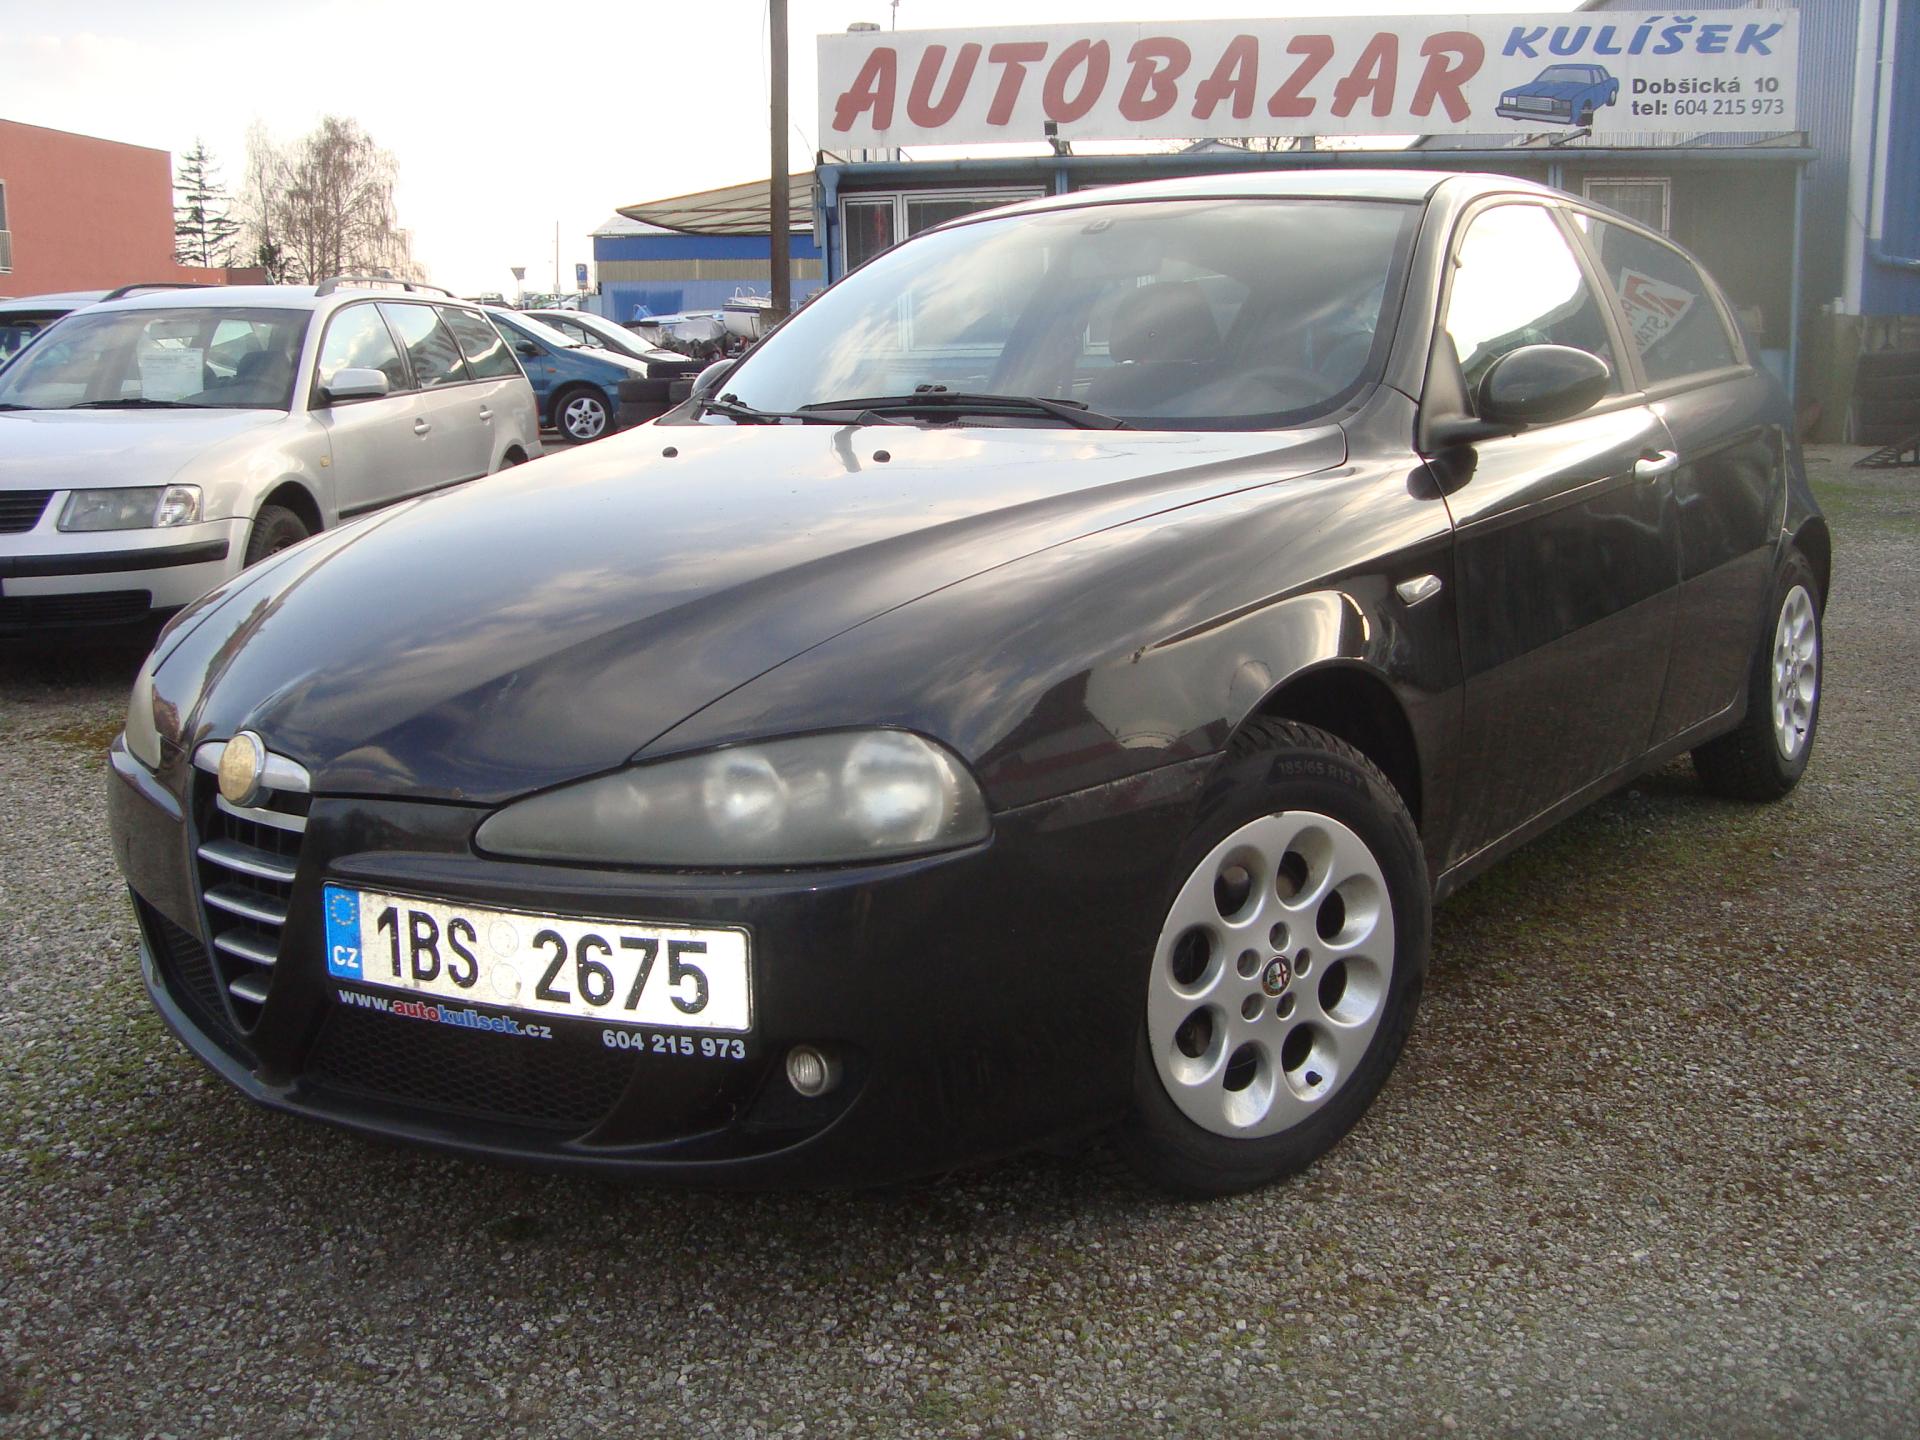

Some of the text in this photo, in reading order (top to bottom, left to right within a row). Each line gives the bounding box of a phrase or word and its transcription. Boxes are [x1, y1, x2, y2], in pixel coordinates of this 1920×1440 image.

[1502, 15, 1782, 58] KULÍŠEK
[832, 31, 1485, 132] AUTOBAZAR
[1631, 77, 1779, 94] Dobšická 10
[1631, 98, 1784, 115] tel: 604 215 973
[333, 945, 359, 968] CZ
[377, 906, 710, 1014] 1BS 2675
[338, 989, 553, 1039] www.autokulisek.cz
[602, 1029, 746, 1059] 604 215 973
